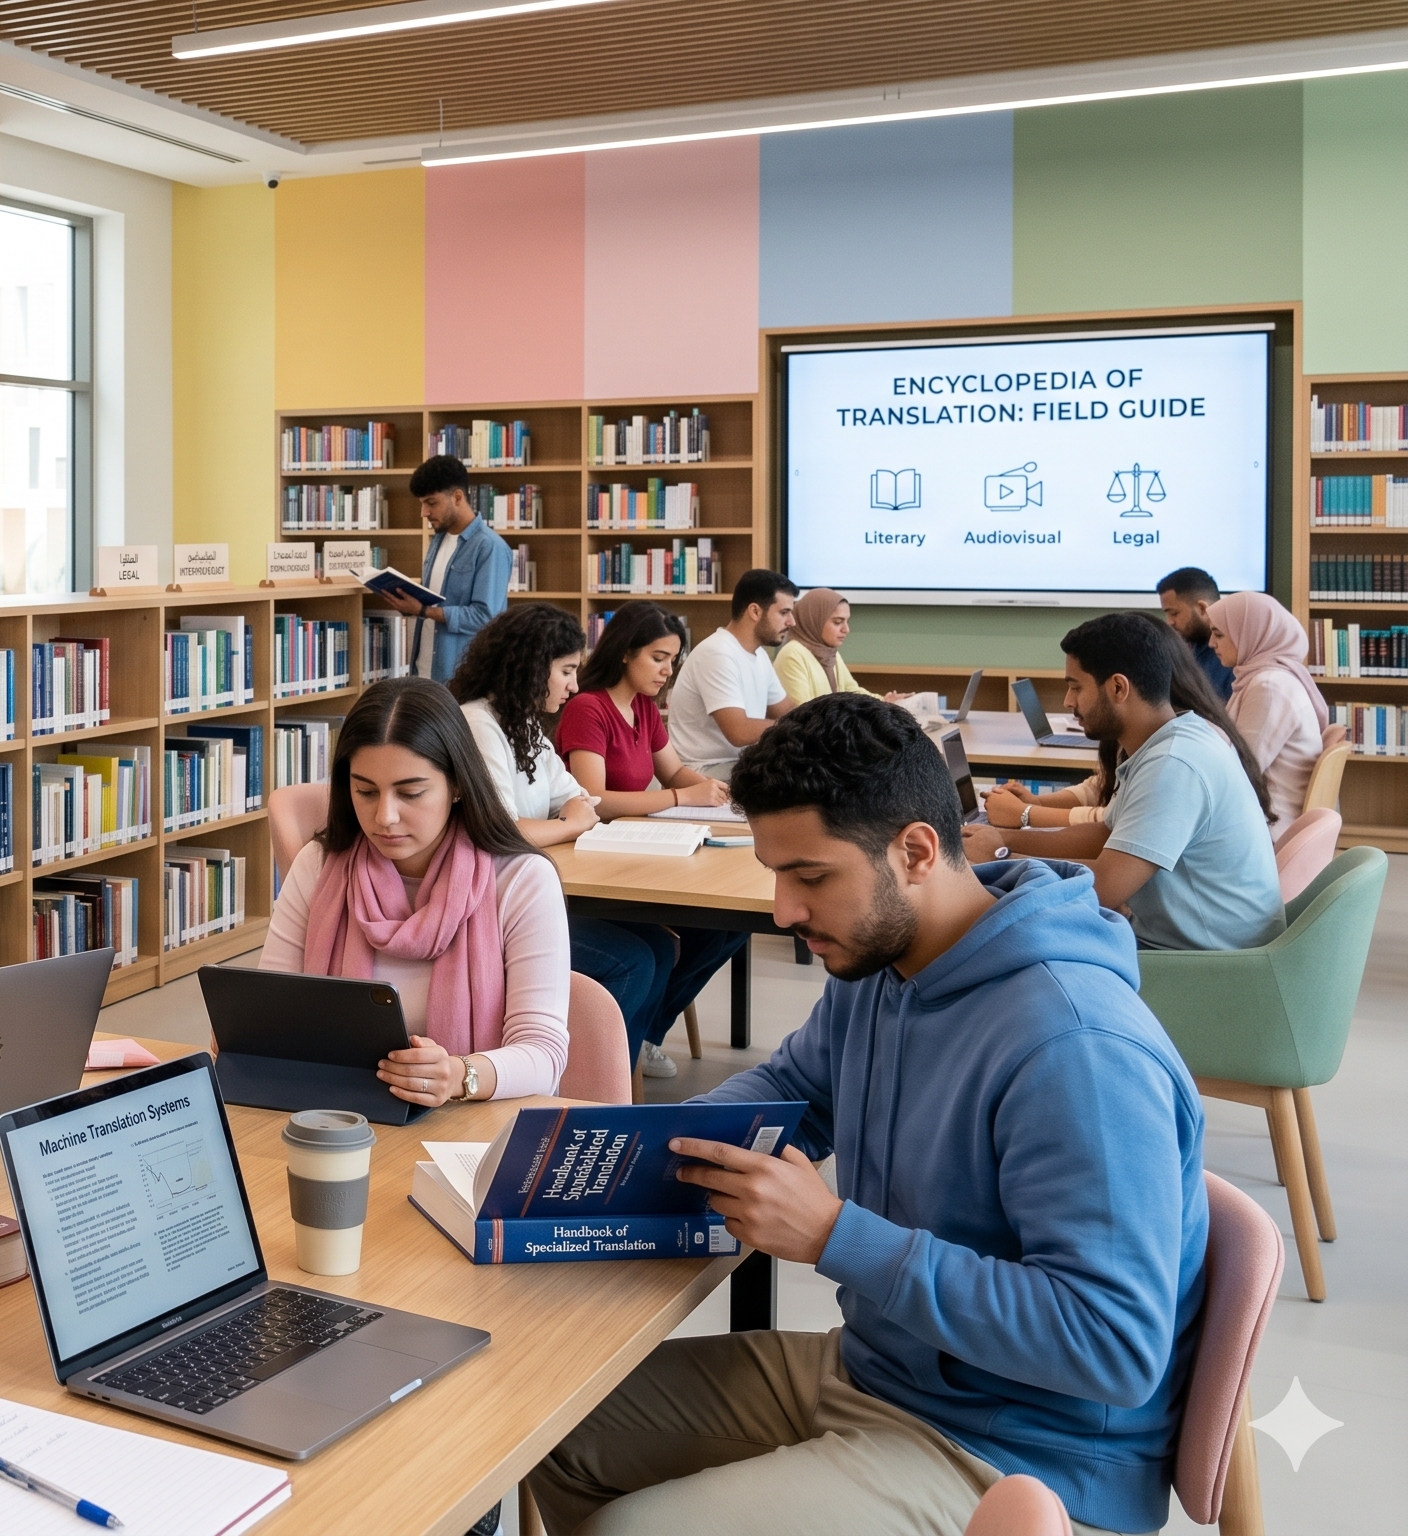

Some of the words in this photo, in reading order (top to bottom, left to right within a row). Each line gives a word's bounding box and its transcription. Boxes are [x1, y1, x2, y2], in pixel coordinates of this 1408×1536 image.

[894, 371, 1096, 395] ENCYCLOPEDIA
[1107, 369, 1142, 388] OF
[837, 404, 1022, 426] TRANSLATION:
[1034, 401, 1108, 421] FIELD
[1119, 398, 1205, 418] GUIDE
[865, 530, 926, 547] Literary
[963, 530, 1062, 545] Audiovisual
[1113, 530, 1161, 547] Legal
[39, 1132, 87, 1156] Machine
[87, 1112, 146, 1139] Translation
[148, 1097, 190, 1121] Systems
[616, 1225, 629, 1237] of
[525, 1240, 589, 1256] Specialized
[593, 1239, 656, 1251] Translation
